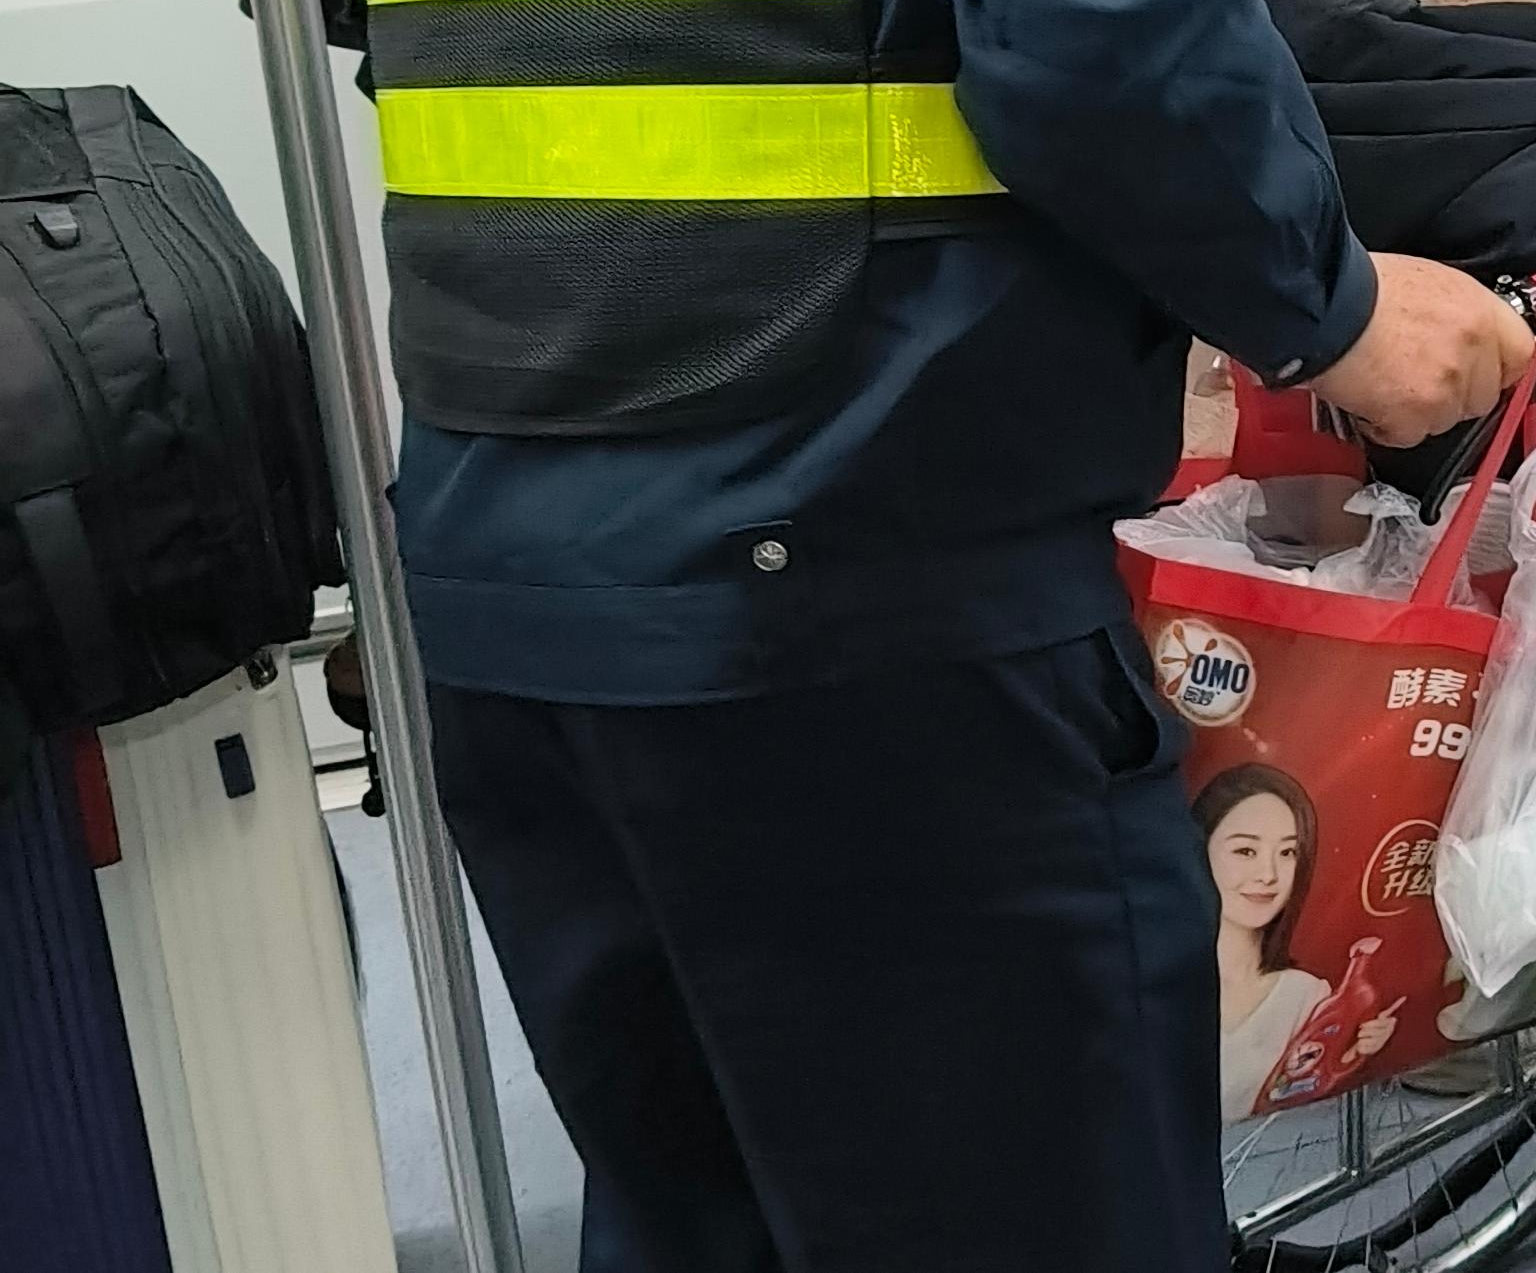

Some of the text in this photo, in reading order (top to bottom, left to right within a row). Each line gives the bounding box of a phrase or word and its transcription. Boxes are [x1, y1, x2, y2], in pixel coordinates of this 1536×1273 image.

[1191, 654, 1249, 693] OMO
[1387, 667, 1468, 709] 酵素
[1410, 719, 1472, 760] 99
